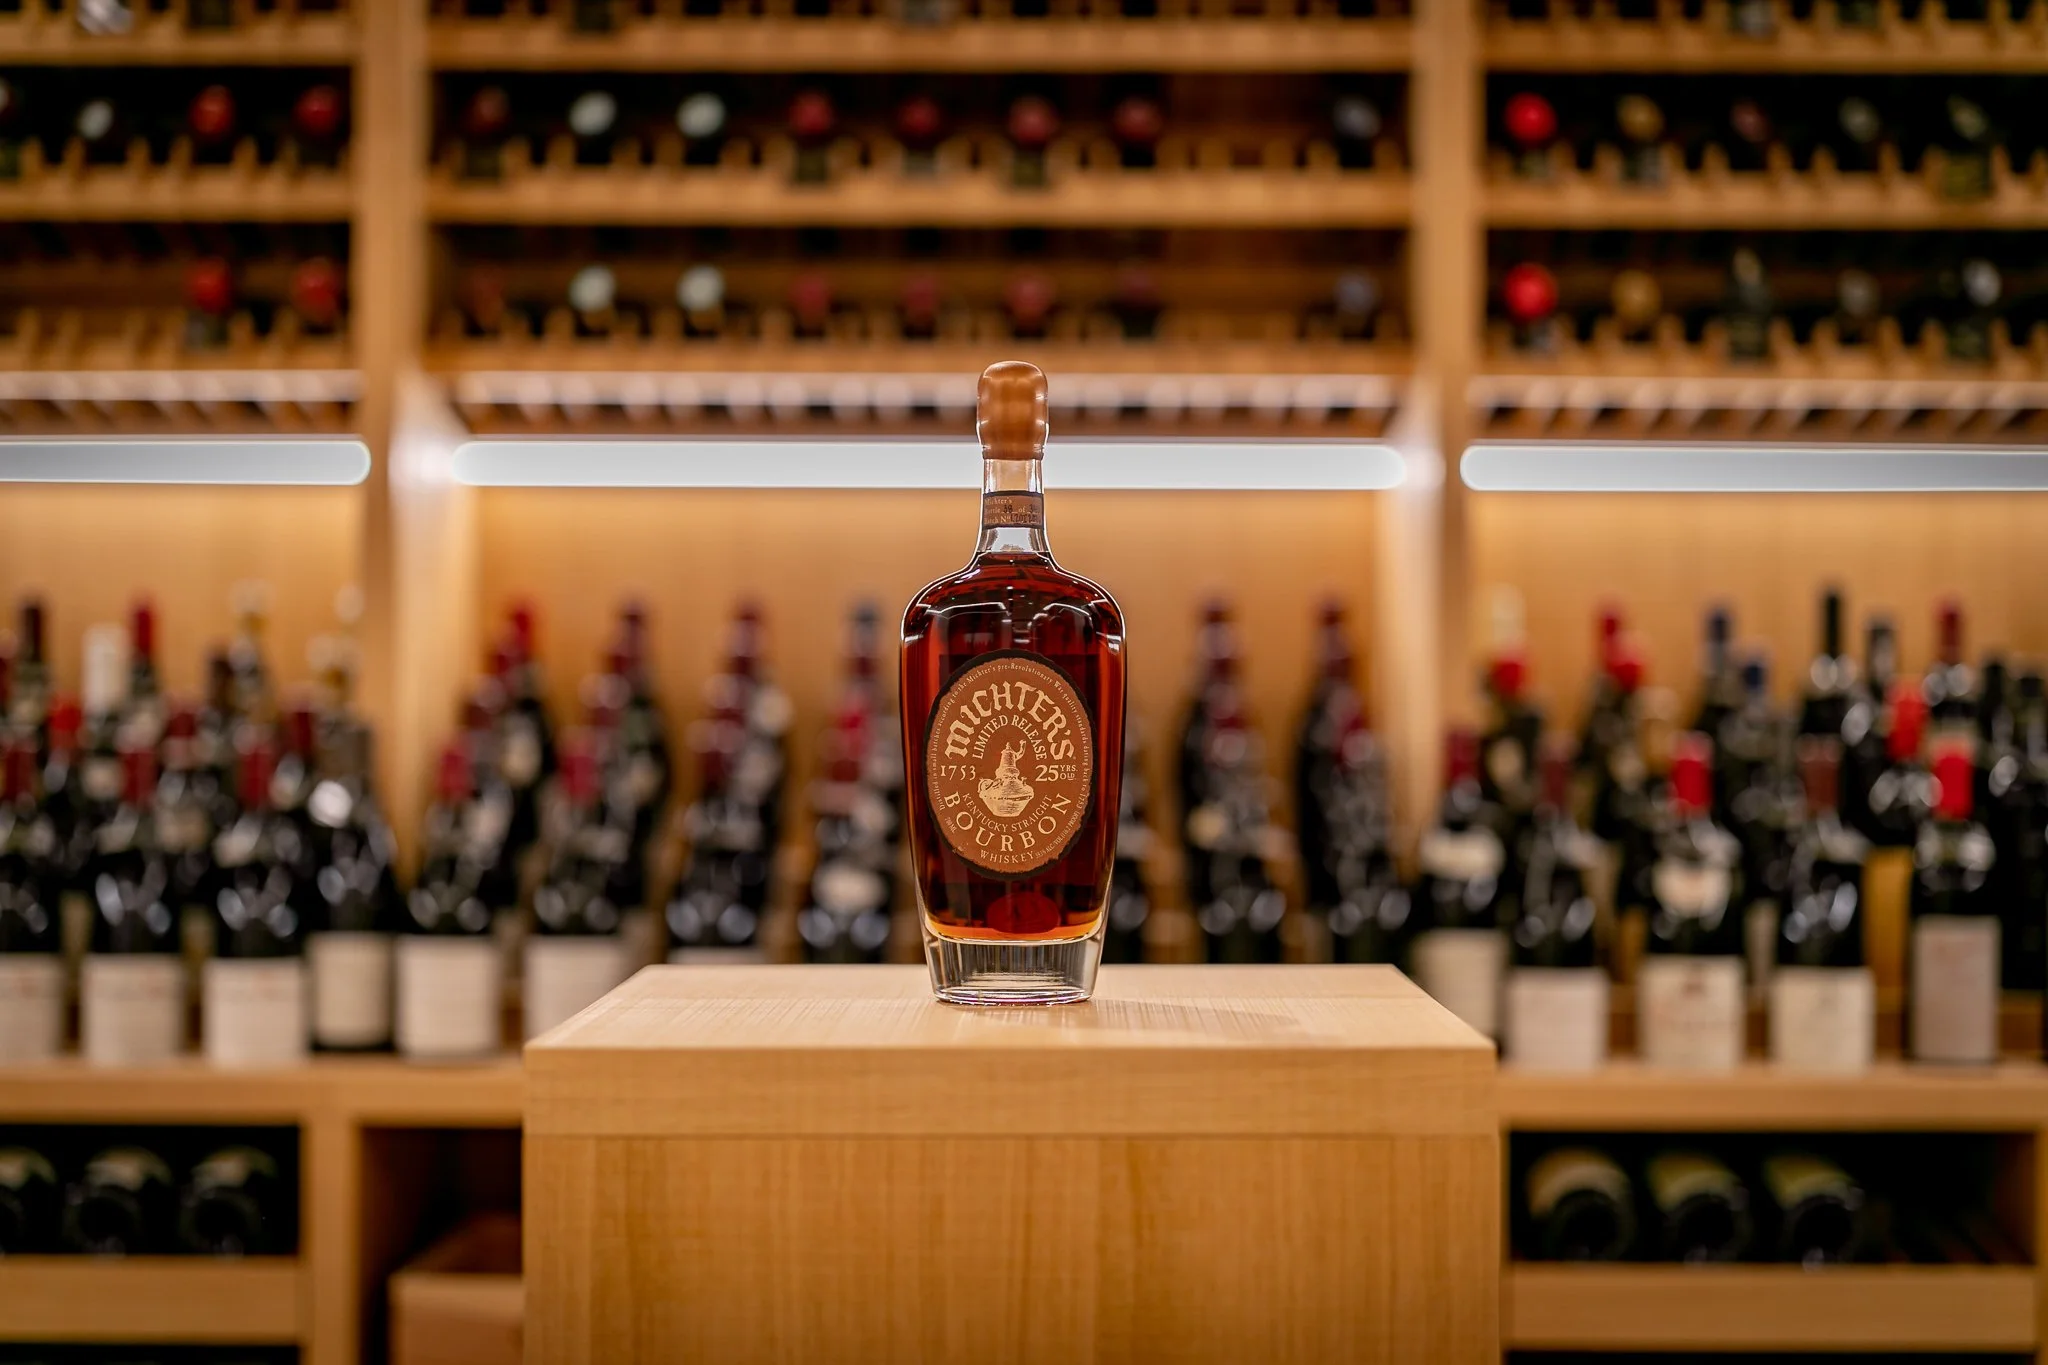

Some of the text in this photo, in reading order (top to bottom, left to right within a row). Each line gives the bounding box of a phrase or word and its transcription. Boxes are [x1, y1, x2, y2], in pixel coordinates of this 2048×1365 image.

[931, 728, 941, 752] batches
[938, 698, 955, 727] according
[957, 682, 967, 692] the
[966, 665, 996, 684] Michter's
[998, 662, 1053, 684] pre-Revolutionary
[1053, 680, 1063, 693] War
[1062, 693, 1077, 714] quality
[1075, 714, 1088, 744] standards
[944, 680, 1075, 760] MICHTER'S
[972, 715, 1047, 761] LIMITED RELEASE
[940, 765, 976, 780] 1753
[1035, 764, 1059, 781] 25
[944, 791, 1072, 852] BOURBON
[962, 792, 1053, 832] KENTUCKY STRAIGHT
[980, 849, 1035, 864] WHISKEY
